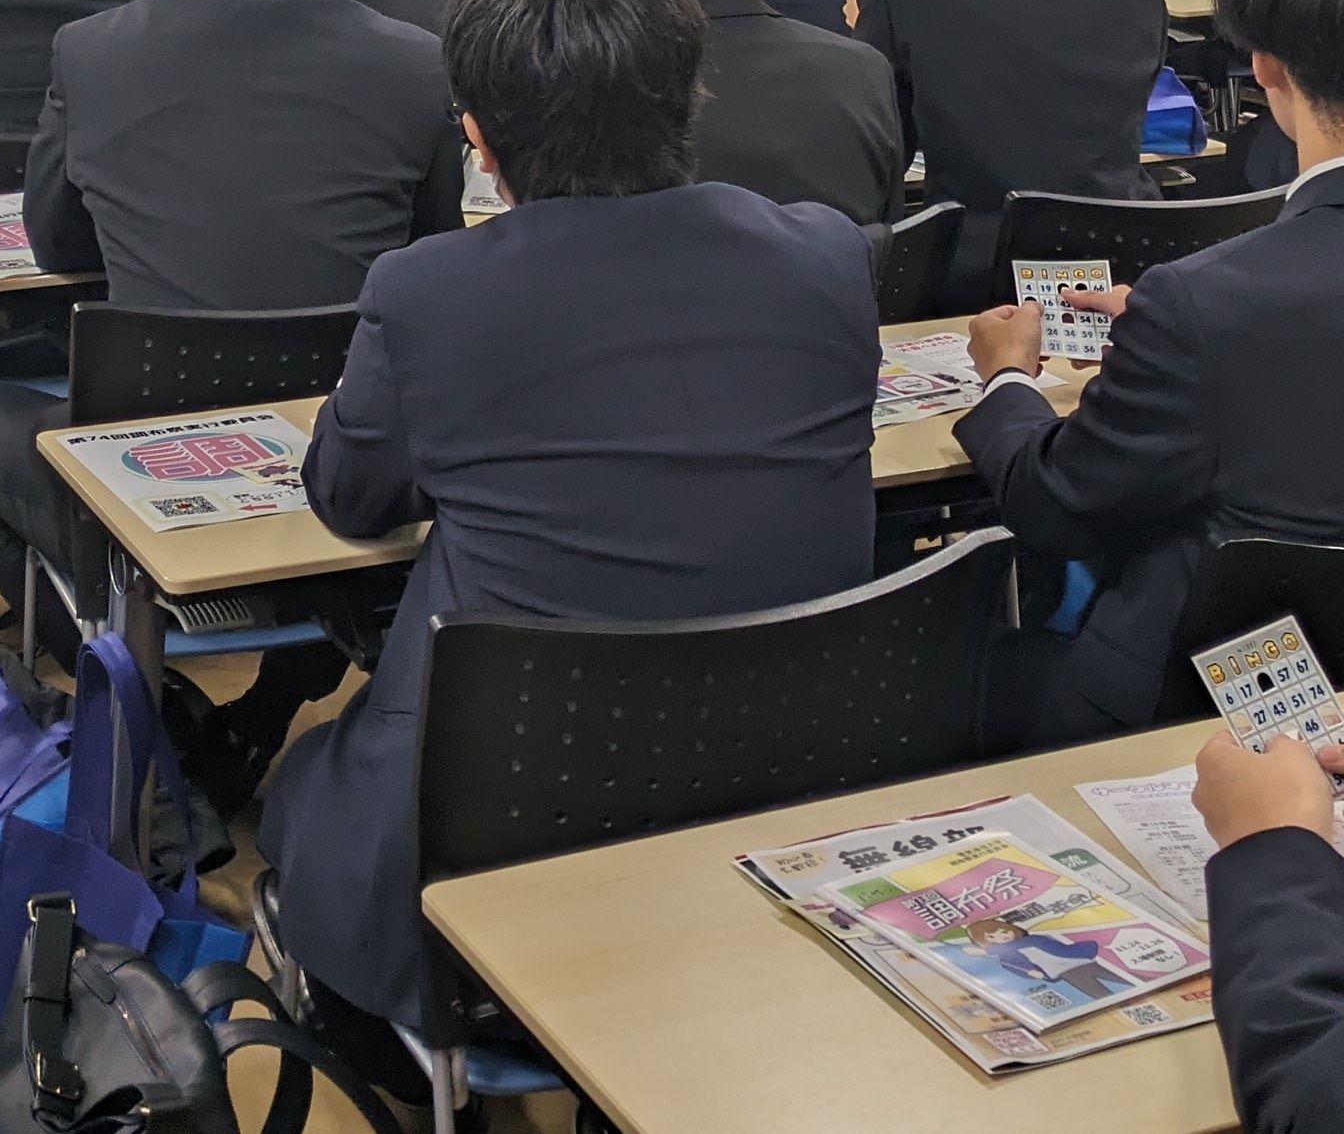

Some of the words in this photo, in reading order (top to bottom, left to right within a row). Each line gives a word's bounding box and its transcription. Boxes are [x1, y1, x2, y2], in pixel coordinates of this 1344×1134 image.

[1040, 284, 1051, 293] 19
[1042, 299, 1054, 307] 16
[1044, 313, 1056, 321] 27
[1079, 315, 1091, 324] 54
[1097, 315, 1109, 324] 63
[1047, 328, 1058, 336] 24
[1082, 331, 1093, 339] 59
[1084, 345, 1096, 354] 56
[1225, 692, 1234, 706] 6
[1239, 684, 1253, 699] 17
[1277, 667, 1291, 683] 57
[1296, 659, 1310, 674] 67
[1253, 709, 1267, 725] 27
[1273, 701, 1287, 717] 43
[1291, 693, 1306, 708] 51
[1309, 684, 1325, 700] 74
[1305, 719, 1320, 734] 46
